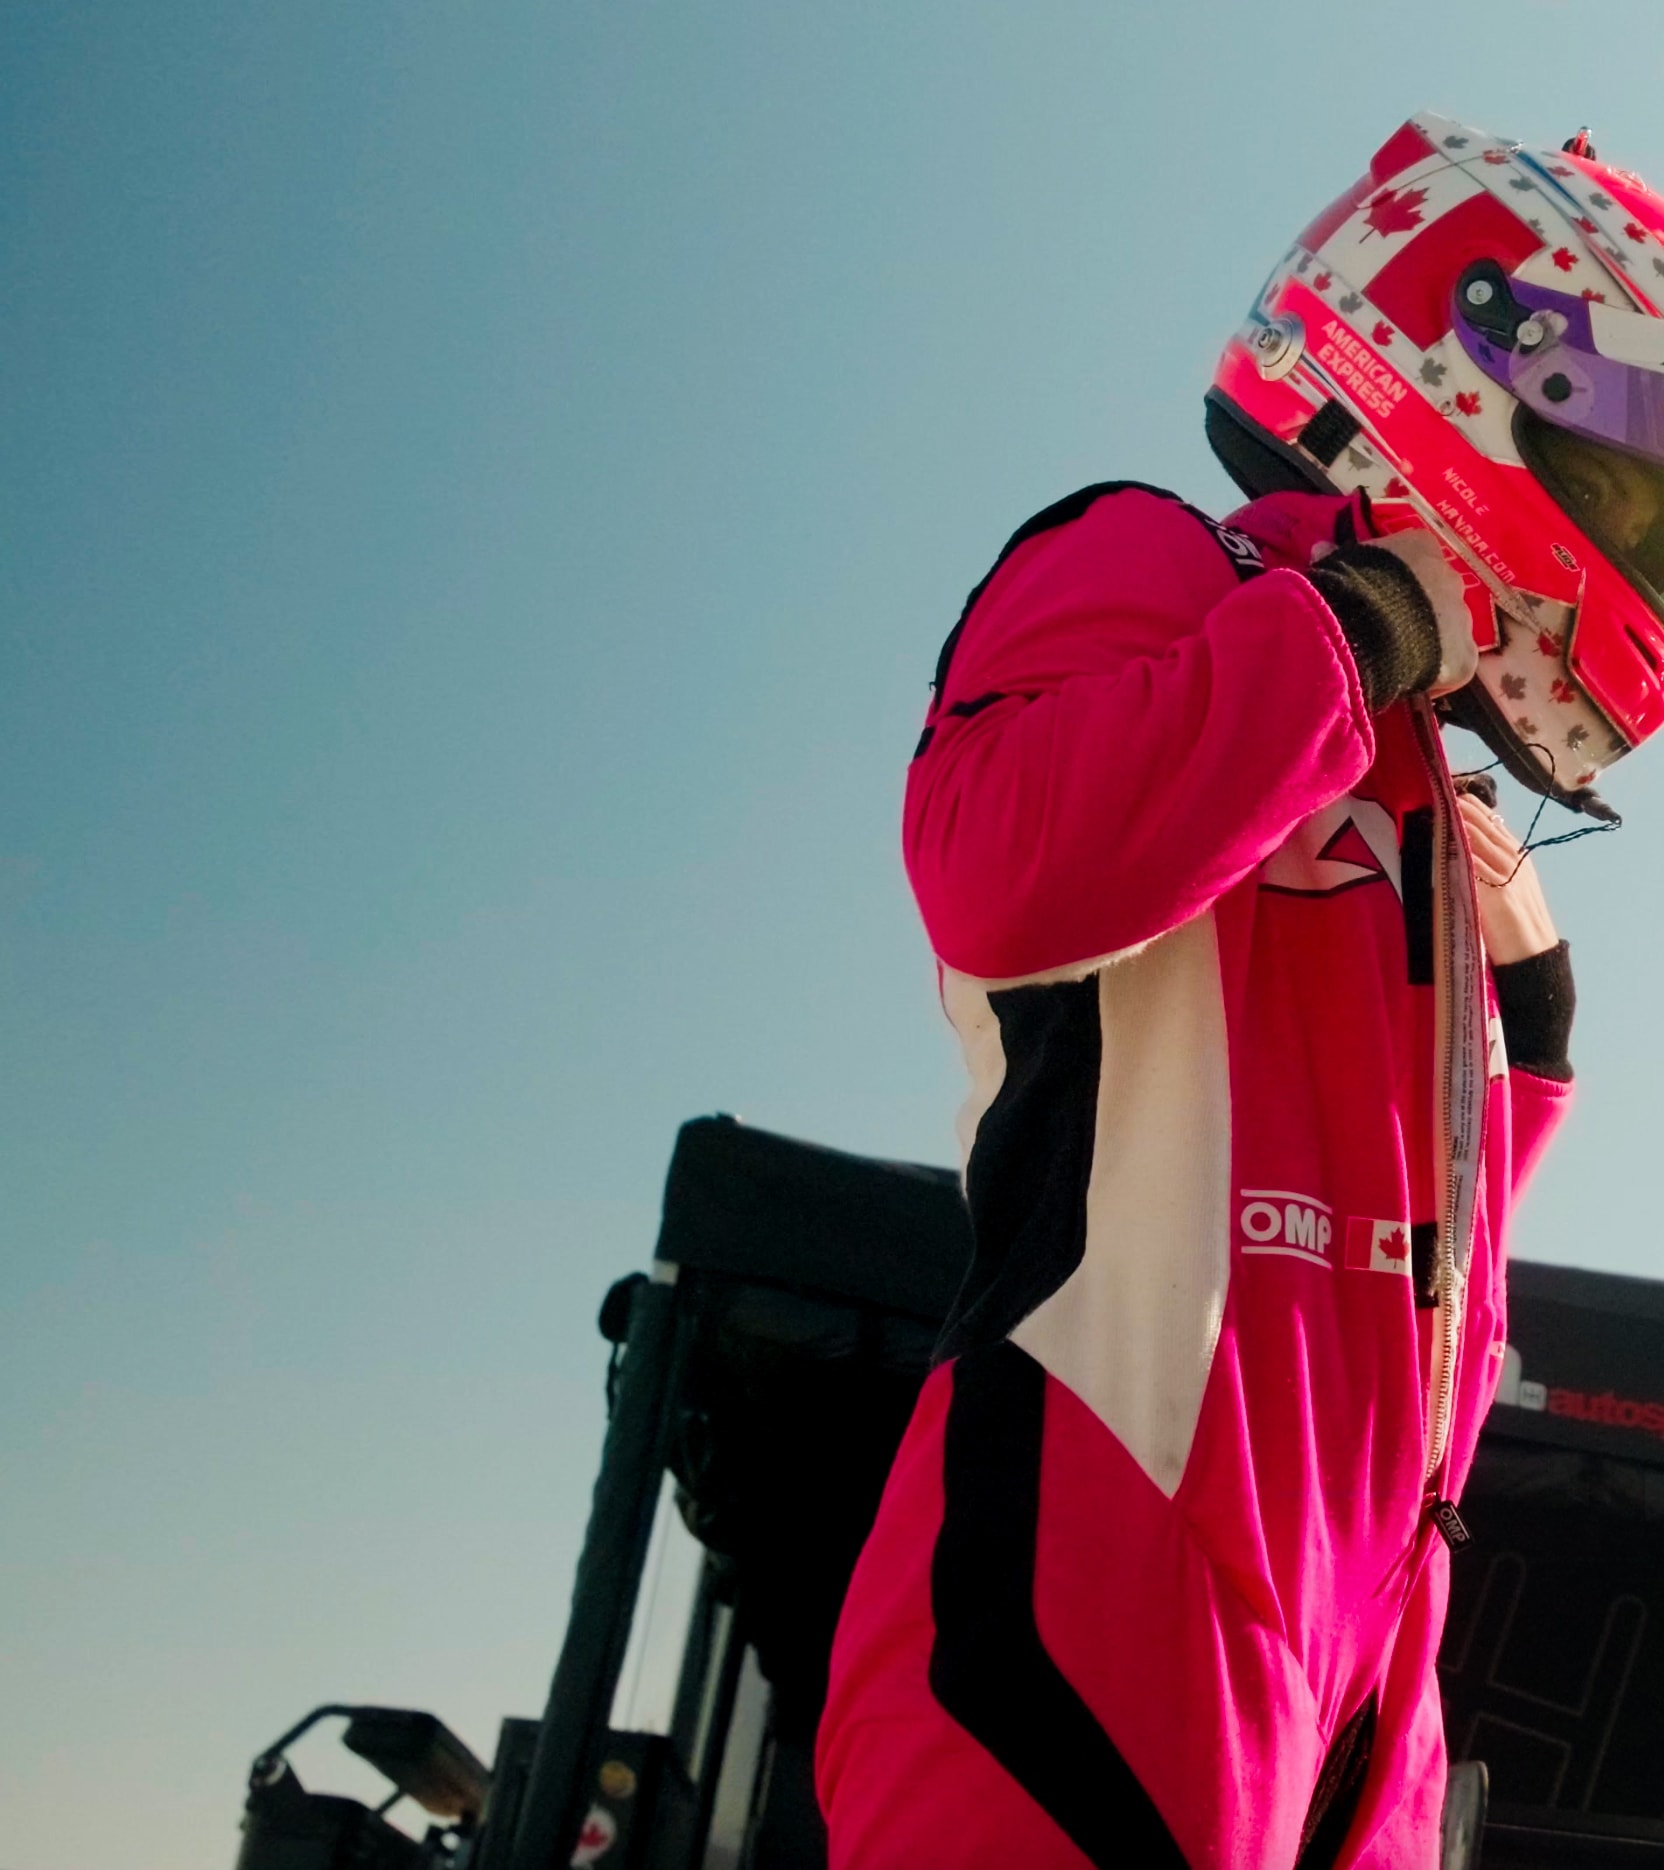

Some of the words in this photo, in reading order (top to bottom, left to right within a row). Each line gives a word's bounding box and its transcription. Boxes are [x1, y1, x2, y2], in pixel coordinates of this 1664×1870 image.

[1316, 343, 1395, 419] EXPRESS
[1321, 320, 1408, 403] AMERICAN
[1442, 467, 1490, 517] NICOLE
[1240, 1201, 1332, 1255] OMP
[1440, 1507, 1466, 1543] OMP
